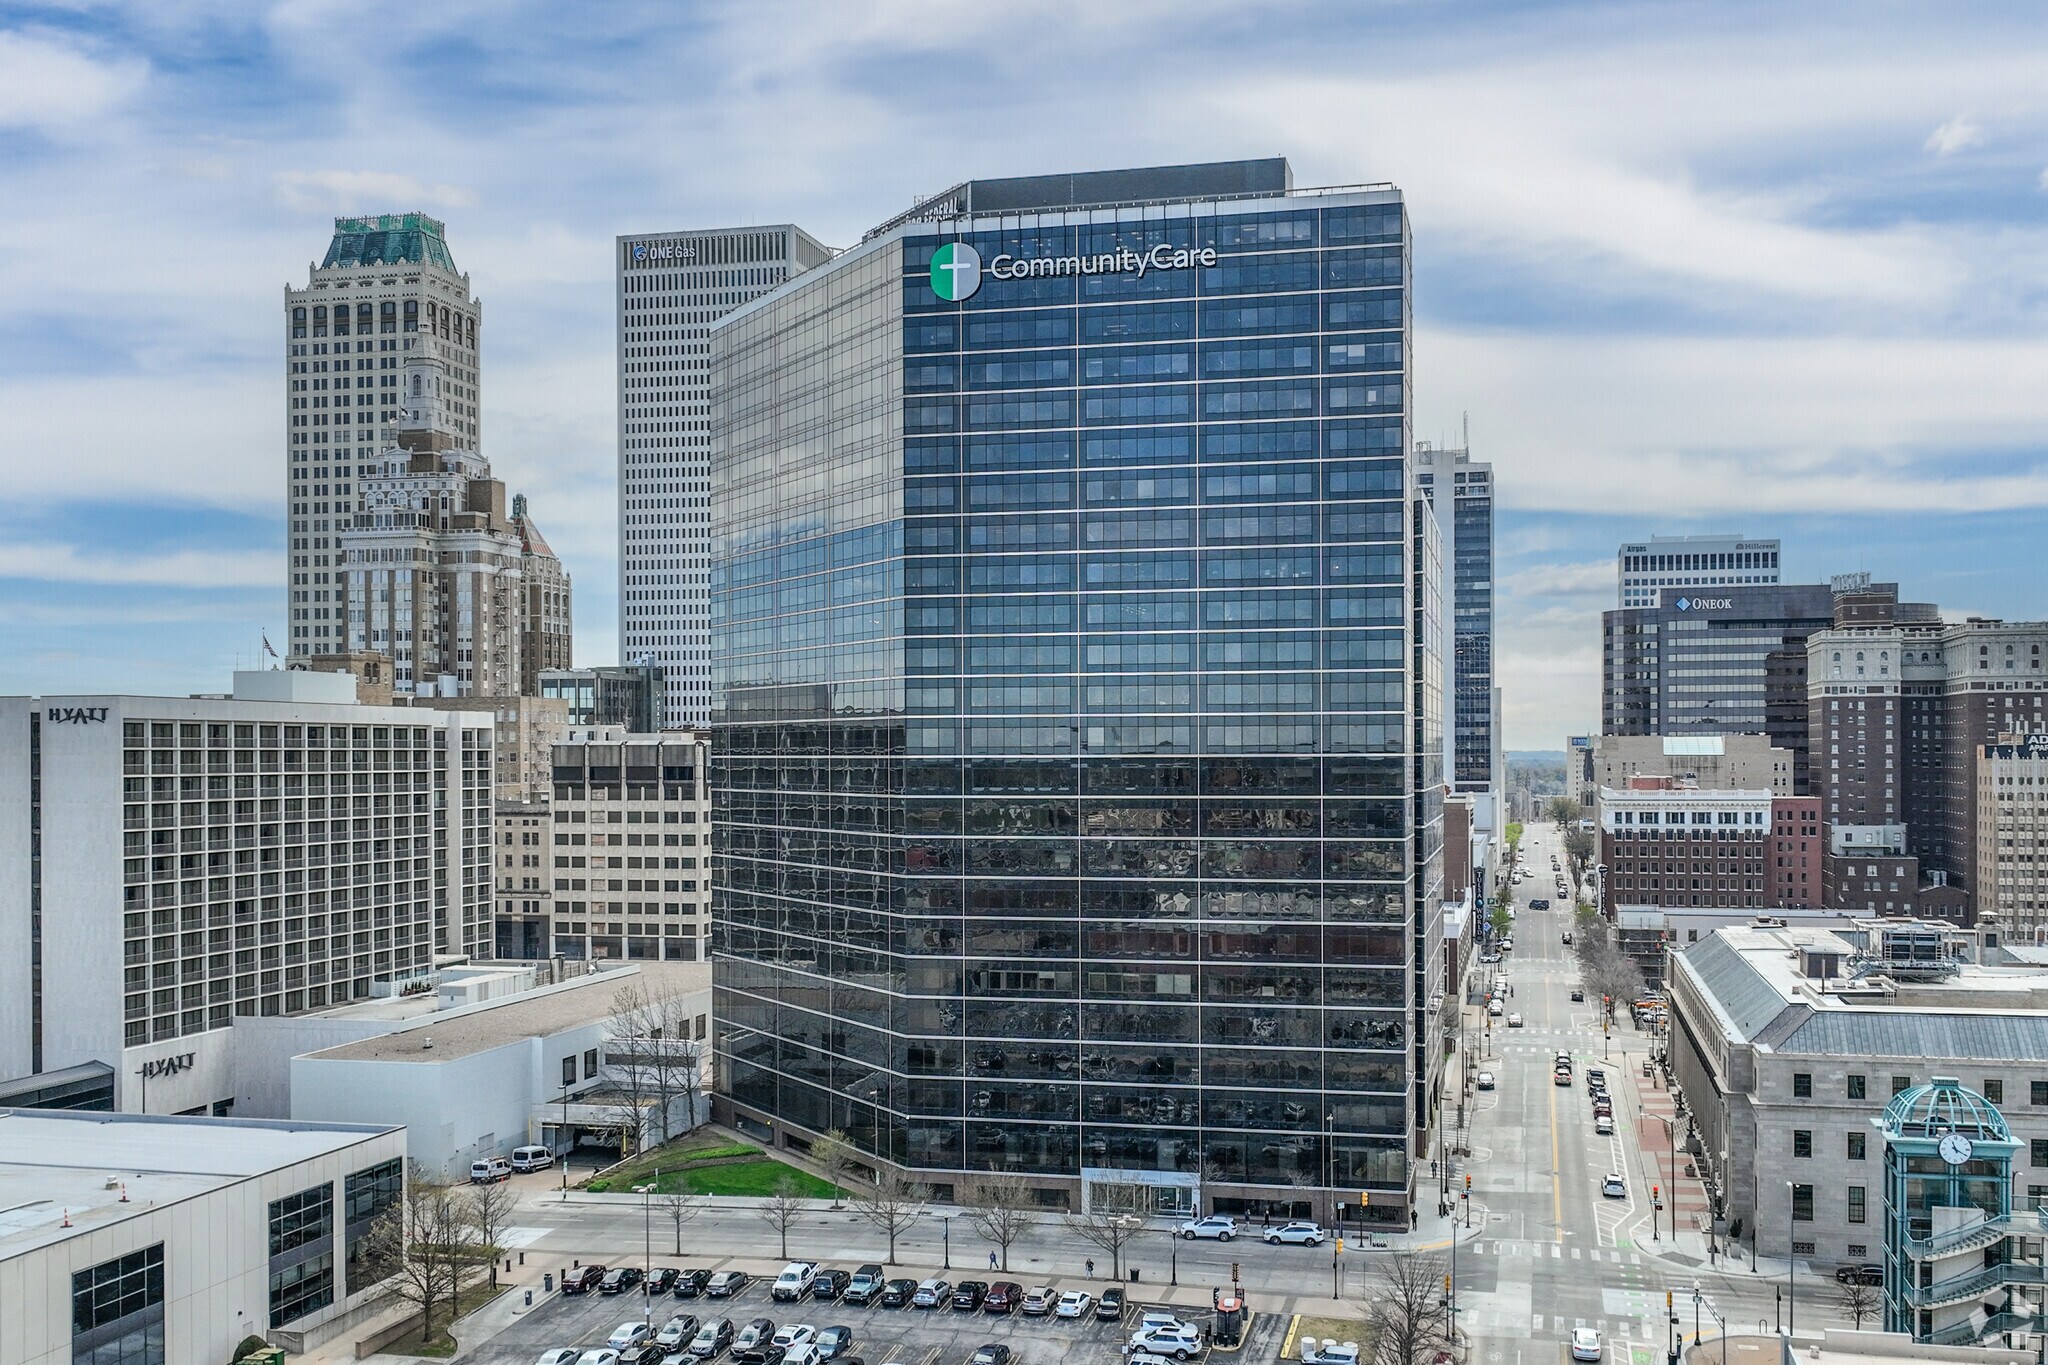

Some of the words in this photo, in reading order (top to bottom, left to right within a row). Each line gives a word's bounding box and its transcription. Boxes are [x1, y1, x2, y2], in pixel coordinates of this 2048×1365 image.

[650, 247, 673, 260] ONE
[675, 245, 696, 259] Gas
[990, 243, 1217, 279] CommunityCare
[1626, 545, 1647, 553] Airgas
[1692, 597, 1732, 610] ONEOK
[48, 707, 109, 725] HYATT
[143, 1052, 196, 1078] HYATT
